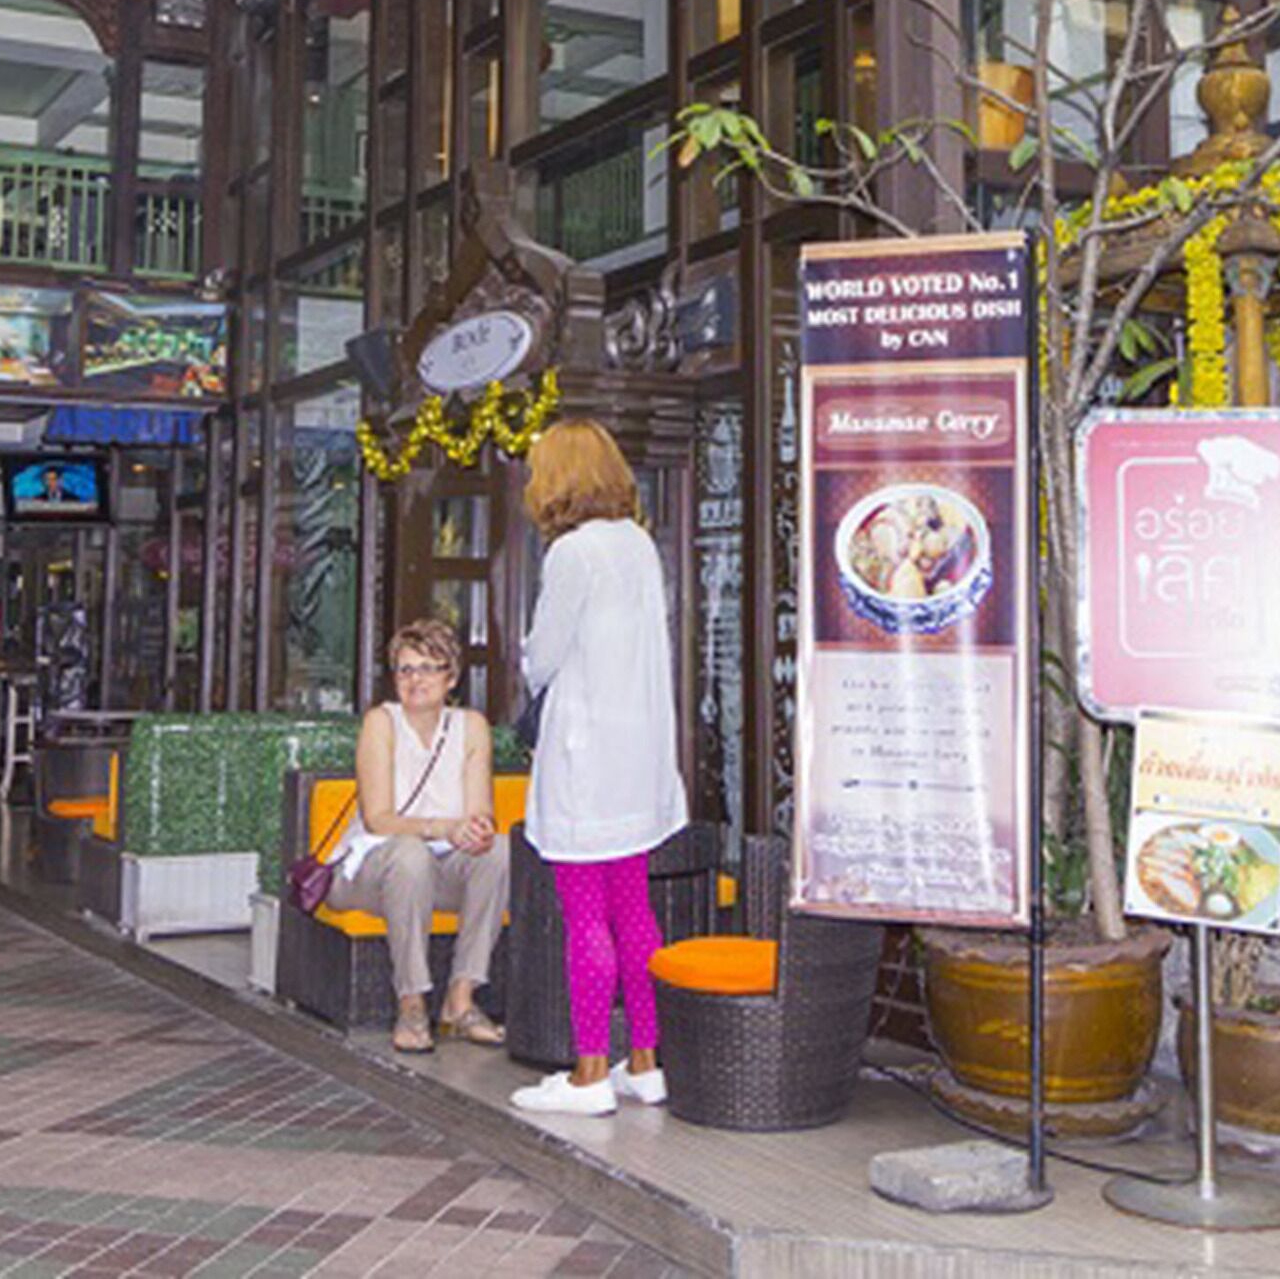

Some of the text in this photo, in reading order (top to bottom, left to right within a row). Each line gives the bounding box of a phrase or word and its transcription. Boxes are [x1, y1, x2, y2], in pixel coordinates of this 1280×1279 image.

[806, 281, 884, 301] WORLD
[890, 274, 963, 296] VOTED
[807, 300, 1021, 325] MOST DELICIOUS DISH
[880, 329, 949, 350] by CNN
